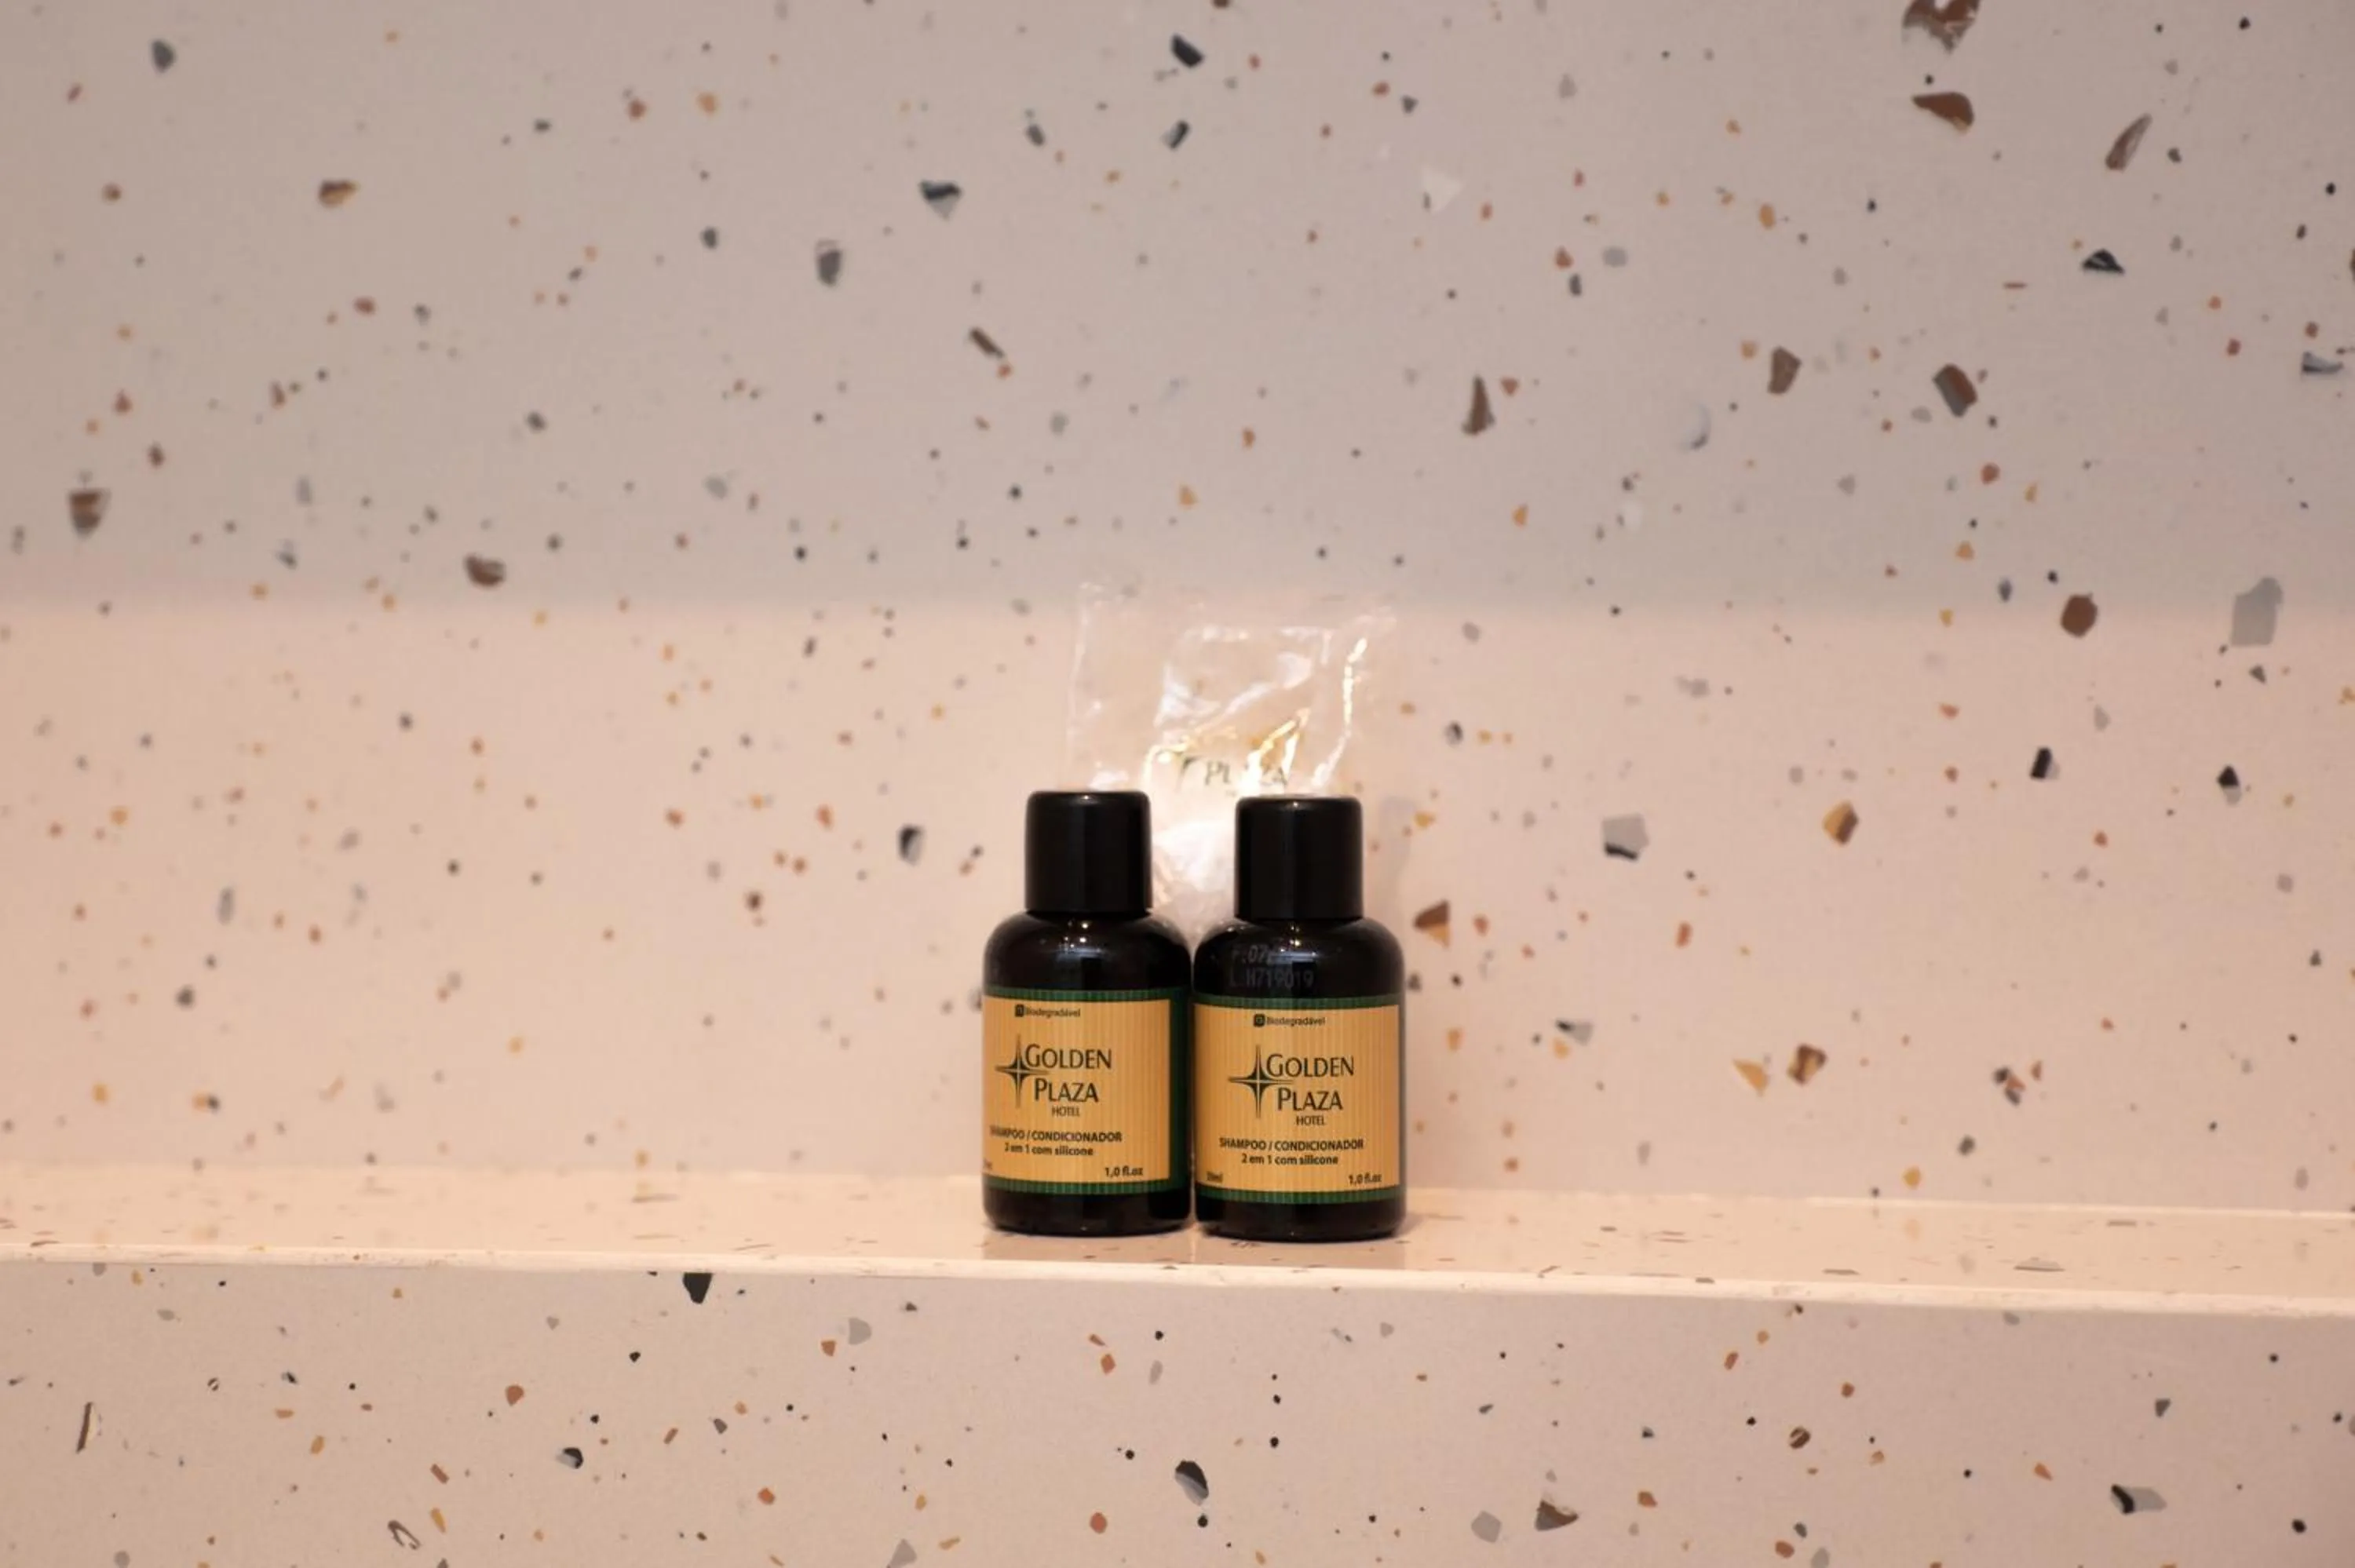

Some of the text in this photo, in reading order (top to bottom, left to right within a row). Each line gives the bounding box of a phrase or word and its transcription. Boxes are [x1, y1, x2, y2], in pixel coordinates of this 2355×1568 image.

[1035, 1078, 1100, 1103] PLAZA
[1277, 1087, 1344, 1111] PLAZA
[1051, 1105, 1080, 1118] HOTEL
[1295, 1114, 1325, 1126] HOTEL
[1031, 1130, 1123, 1143] CONDICIONADOR
[1010, 1144, 1024, 1154] em
[1031, 1145, 1053, 1156] com
[1054, 1144, 1094, 1156] silicone
[1219, 1137, 1266, 1150] SHAMPOO
[1274, 1139, 1364, 1151] CONDICIONADOR
[1241, 1153, 1247, 1165] 2
[1249, 1154, 1265, 1165] em
[1274, 1155, 1297, 1165] com
[1299, 1154, 1338, 1165] silicone
